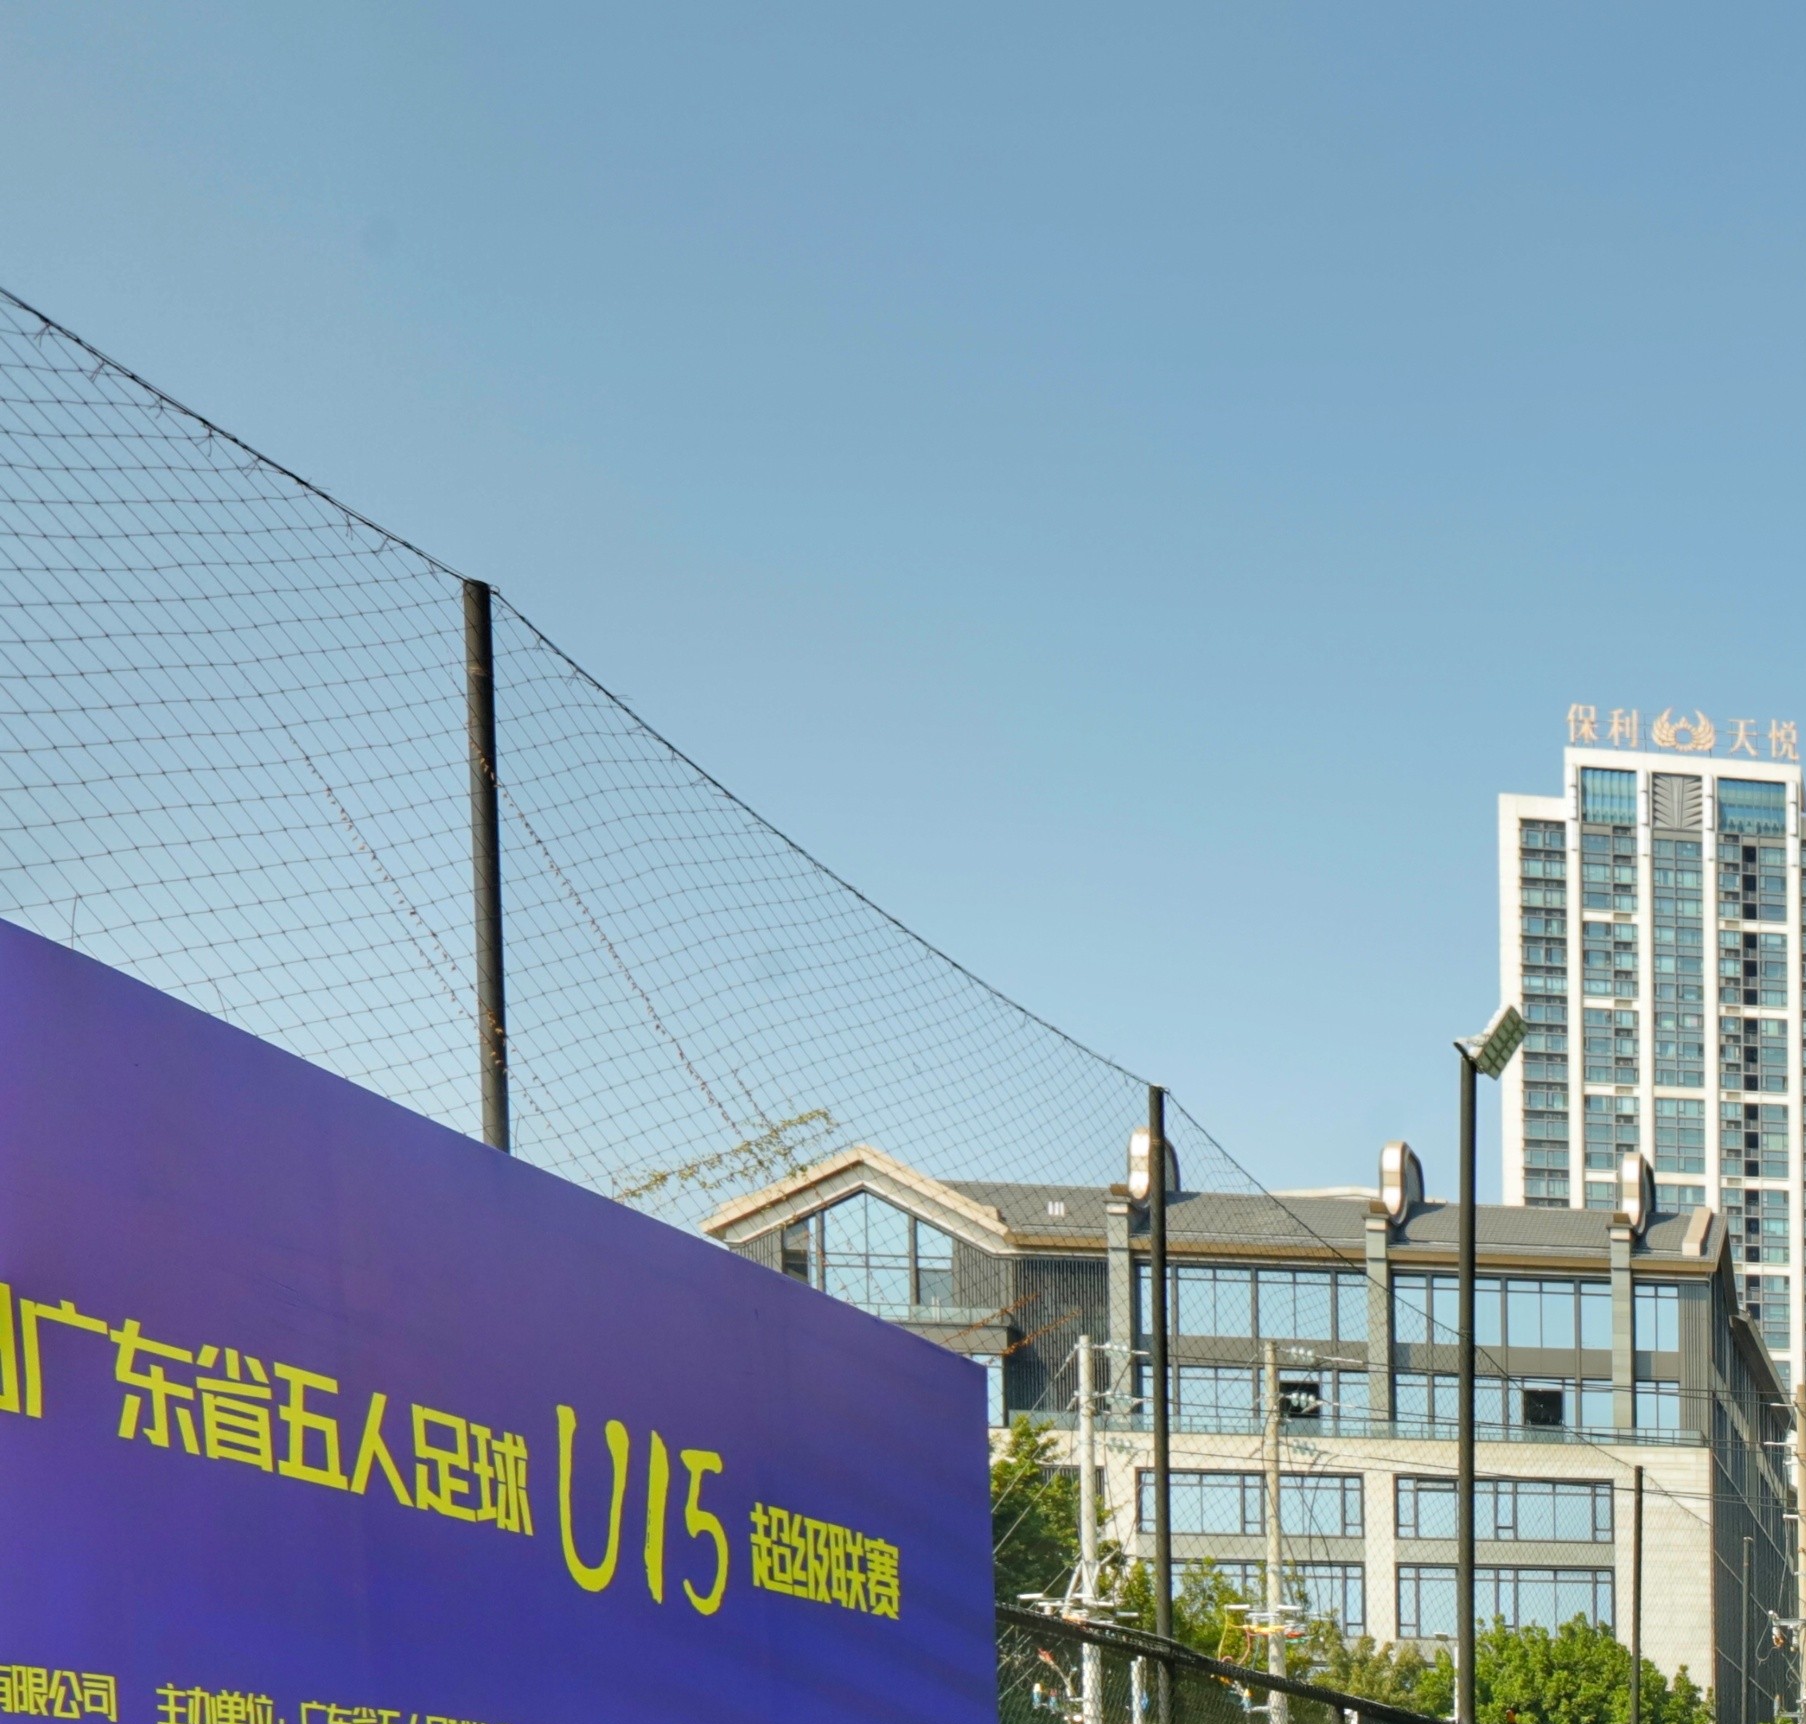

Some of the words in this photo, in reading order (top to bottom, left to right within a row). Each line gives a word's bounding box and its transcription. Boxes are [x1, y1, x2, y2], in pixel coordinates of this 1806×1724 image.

[1567, 703, 1640, 749] 保利
[1726, 717, 1799, 760] 天悦
[556, 1404, 729, 1616] U15
[750, 1502, 900, 1620] 超级联赛
